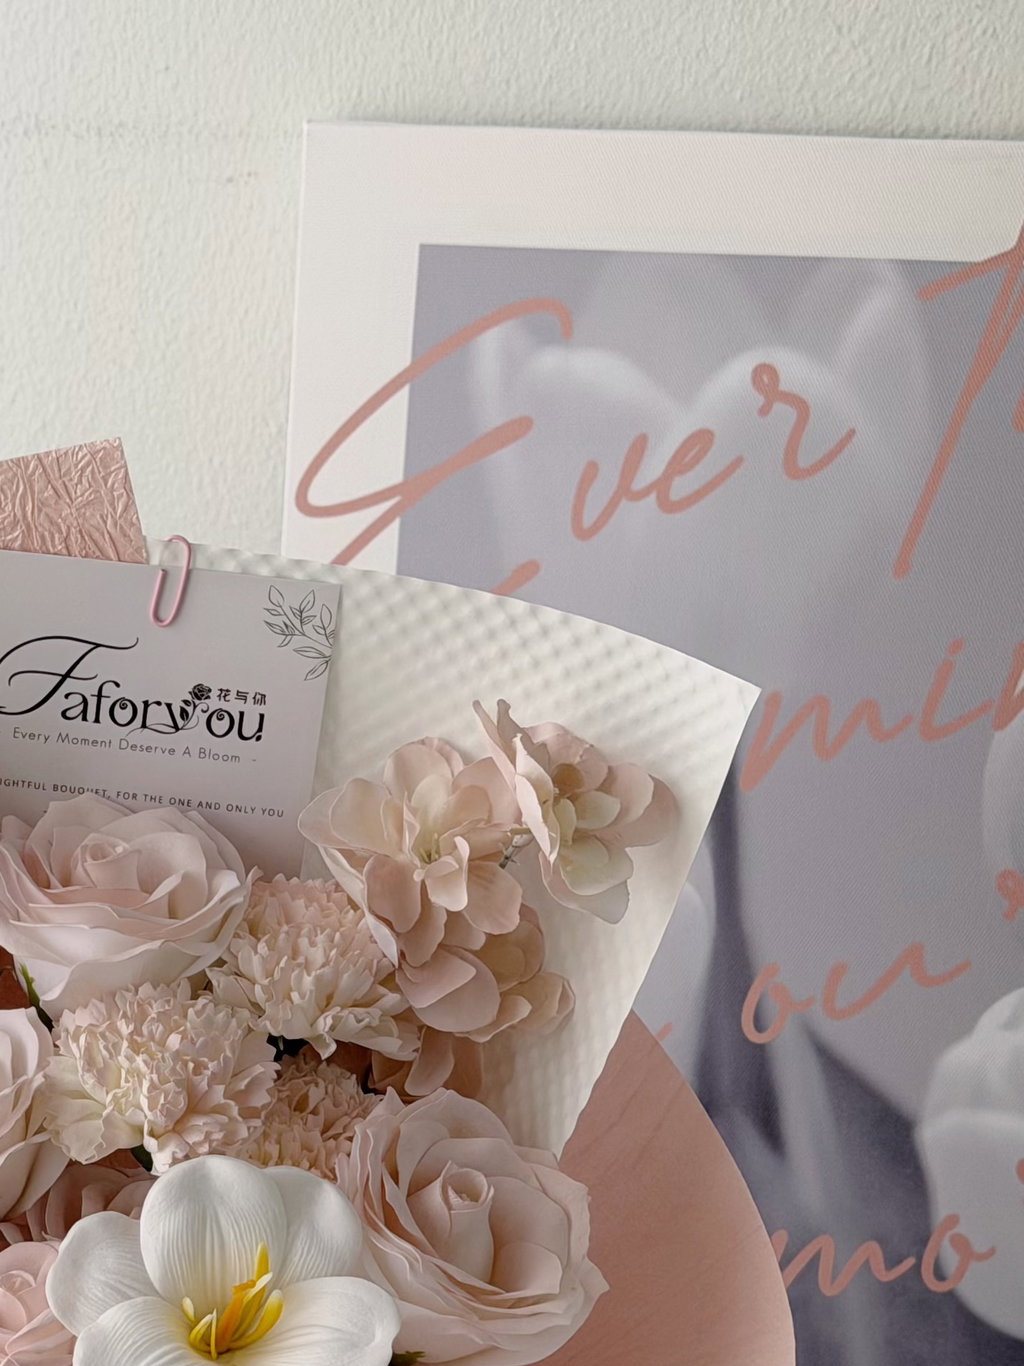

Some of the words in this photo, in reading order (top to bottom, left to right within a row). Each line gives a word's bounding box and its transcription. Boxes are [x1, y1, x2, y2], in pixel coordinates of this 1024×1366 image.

[13, 727, 50, 743] Every
[56, 732, 112, 748] Moment
[119, 738, 176, 756] Deserve
[182, 746, 192, 757] A
[198, 747, 241, 763] Bloom
[116, 790, 138, 801] FOR
[143, 793, 163, 805] THE
[169, 797, 193, 808] ONE
[197, 800, 221, 811] AND
[226, 803, 257, 815] ONLY
[261, 807, 285, 818] YOU
